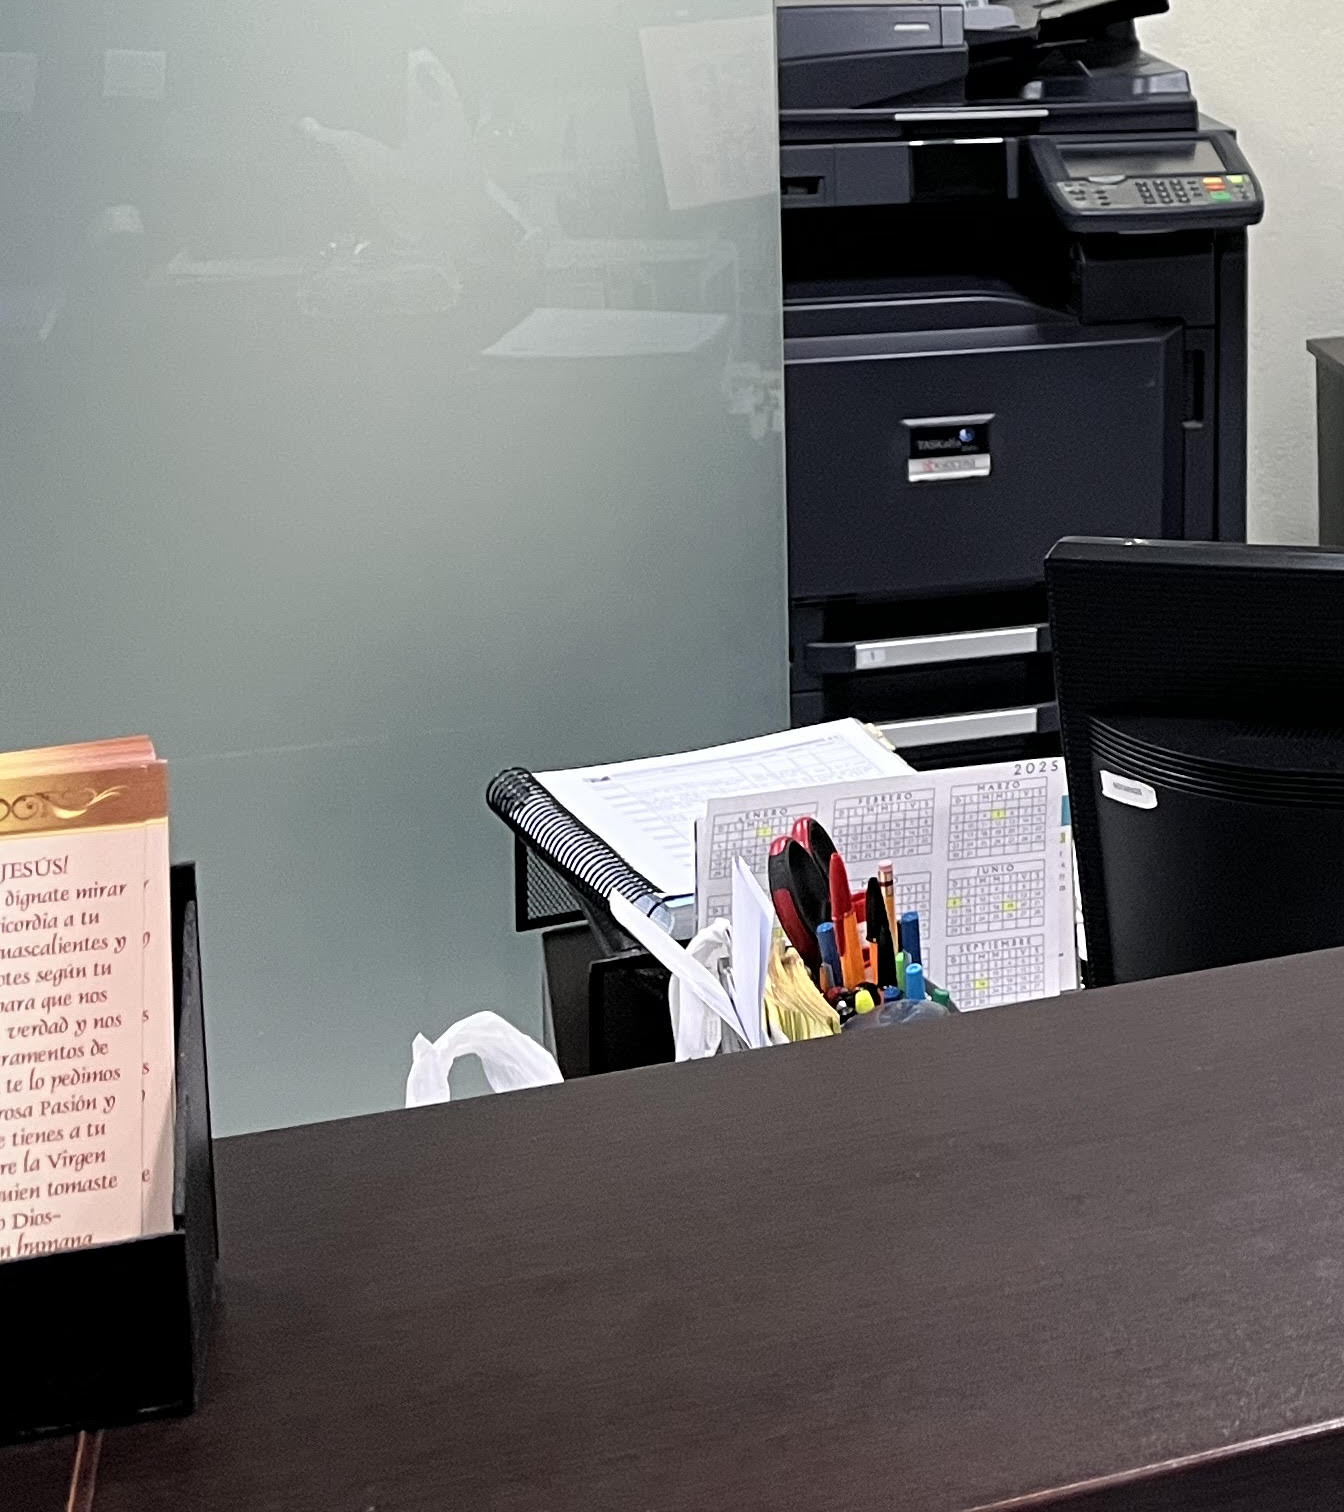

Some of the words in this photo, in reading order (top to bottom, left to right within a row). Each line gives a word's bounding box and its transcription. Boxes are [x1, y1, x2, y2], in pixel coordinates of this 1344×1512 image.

[1014, 760, 1059, 775] 2025
[0, 855, 68, 884] JESÚS!
[5, 889, 69, 911] dignate
[76, 880, 127, 900] mirar
[63, 914, 74, 928] a
[81, 911, 100, 926] tu
[113, 935, 127, 954] y
[35, 963, 87, 987] según
[93, 962, 112, 977] tu
[41, 992, 72, 1014] que
[78, 989, 108, 1005] nos
[7, 1015, 69, 1040] verdad
[74, 1018, 87, 1038] y
[93, 1014, 122, 1029] nos
[90, 1038, 109, 1057] de
[6, 1079, 22, 1094] te
[29, 1067, 45, 1091] lo
[50, 1066, 121, 1094] pedimos
[40, 1094, 97, 1117] Pasión
[103, 1095, 116, 1114] y
[12, 1127, 64, 1147] tienes
[69, 1125, 80, 1140] a
[86, 1122, 106, 1138] tu
[23, 1149, 40, 1174] la
[48, 1149, 106, 1172] Virgen
[47, 1175, 118, 1198] tomaste
